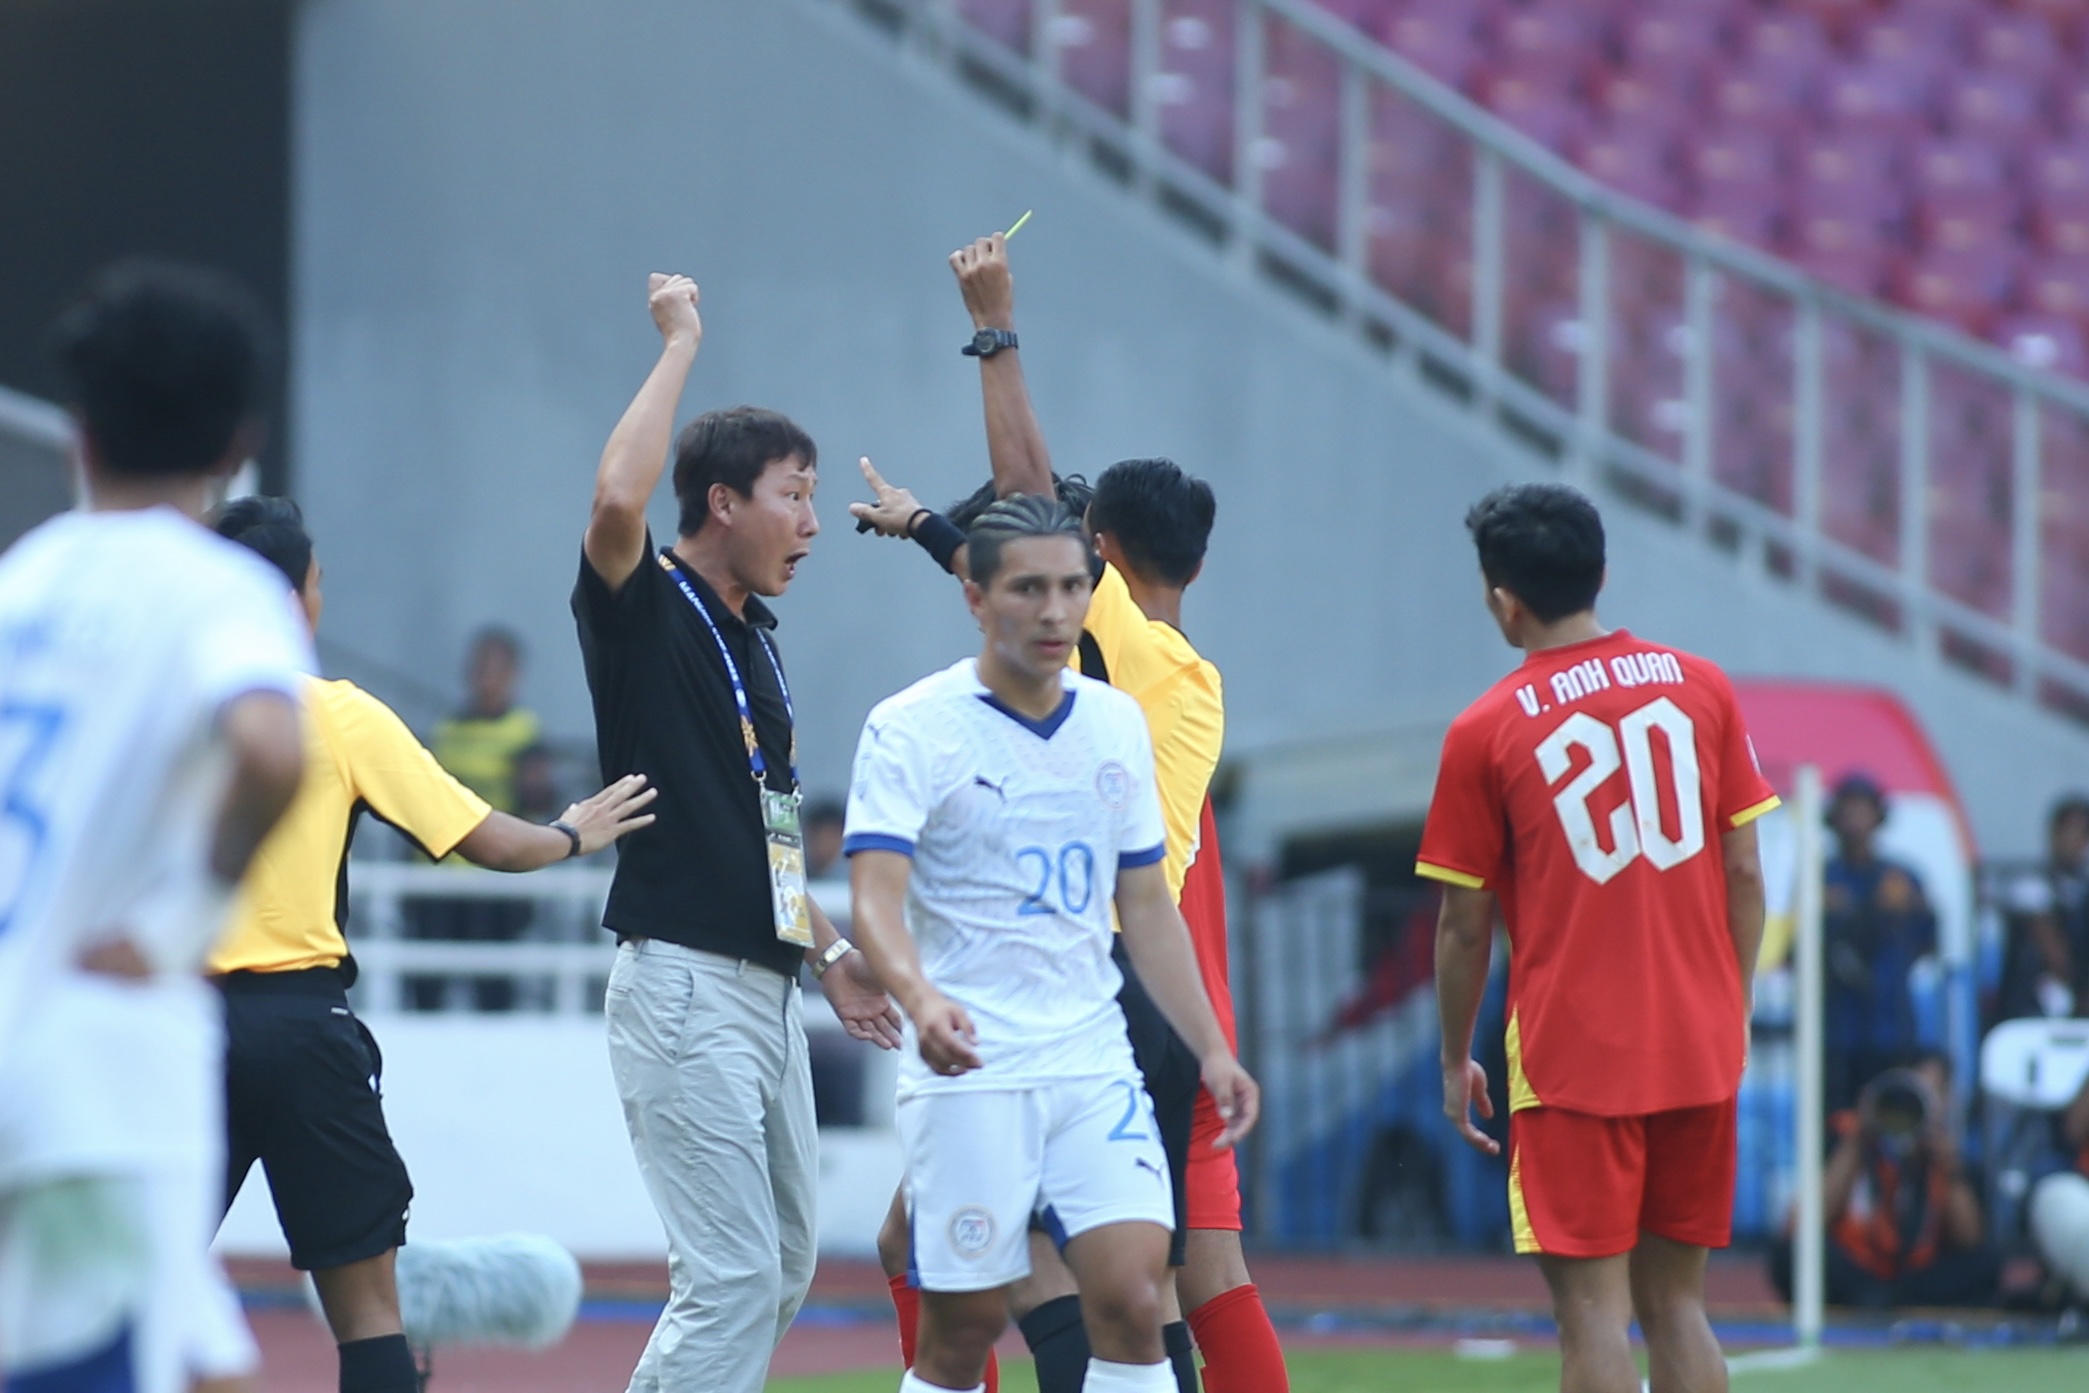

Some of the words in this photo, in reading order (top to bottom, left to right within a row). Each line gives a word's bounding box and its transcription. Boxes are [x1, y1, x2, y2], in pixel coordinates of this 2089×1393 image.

[1515, 684, 1551, 717] V.
[1551, 658, 1611, 704] ANH
[1610, 652, 1684, 687] QUAN
[1534, 695, 1705, 886] 20
[1015, 840, 1094, 916] 20
